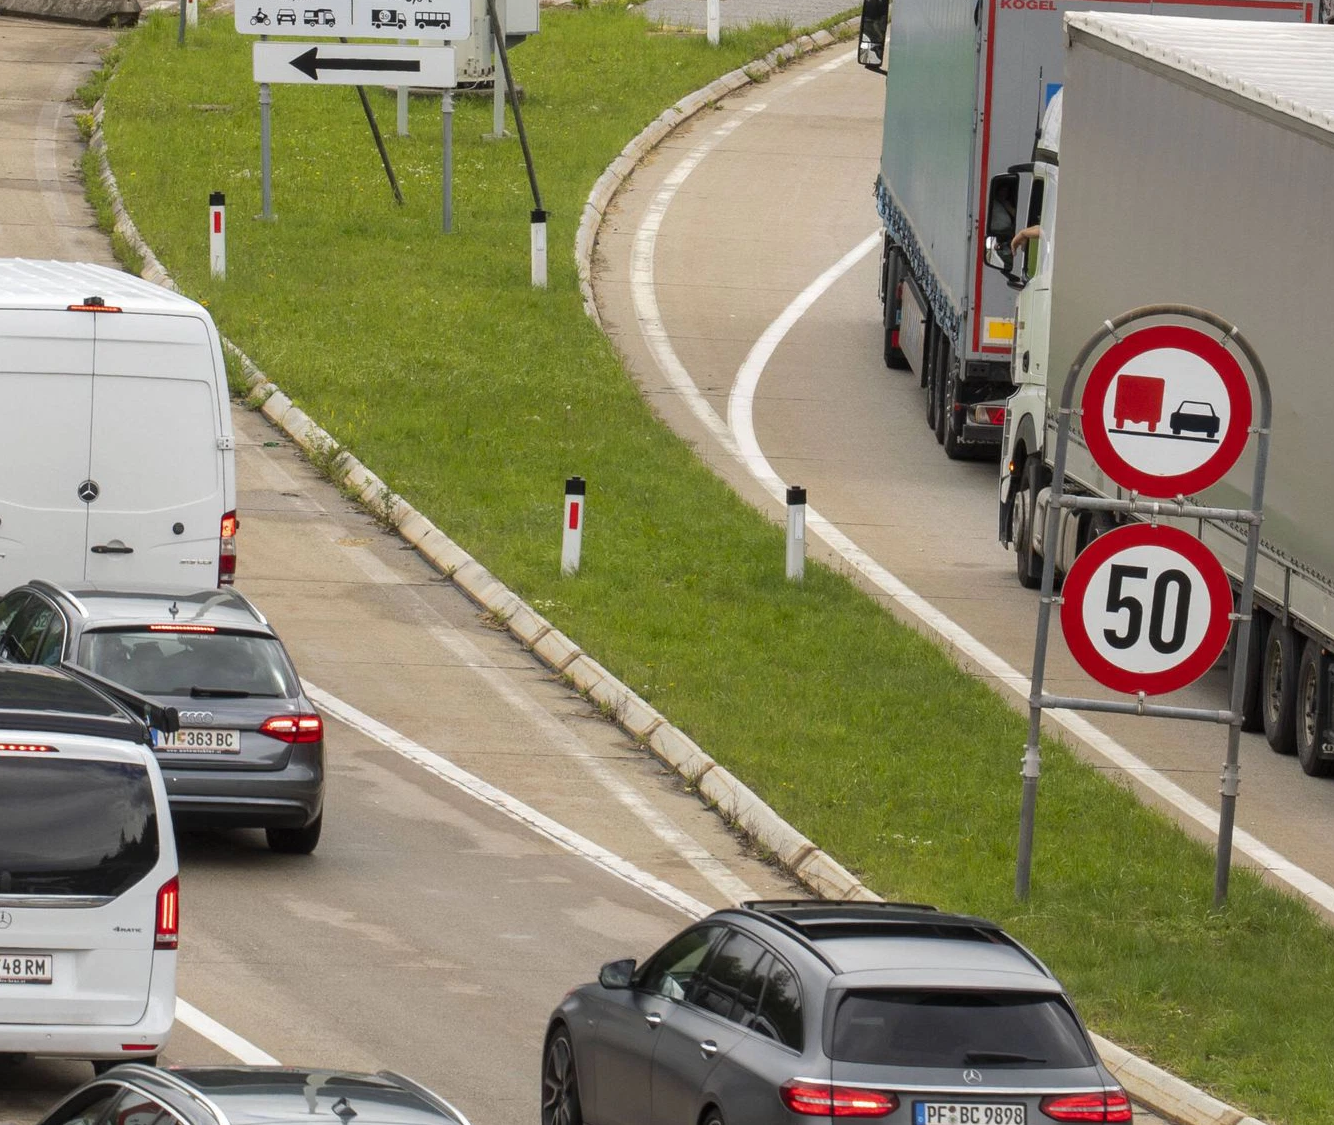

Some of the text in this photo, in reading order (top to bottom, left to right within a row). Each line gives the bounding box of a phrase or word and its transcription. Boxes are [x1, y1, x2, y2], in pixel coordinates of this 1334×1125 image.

[1102, 563, 1192, 654] 50
[926, 1106, 1024, 1125] PF BC 9898
